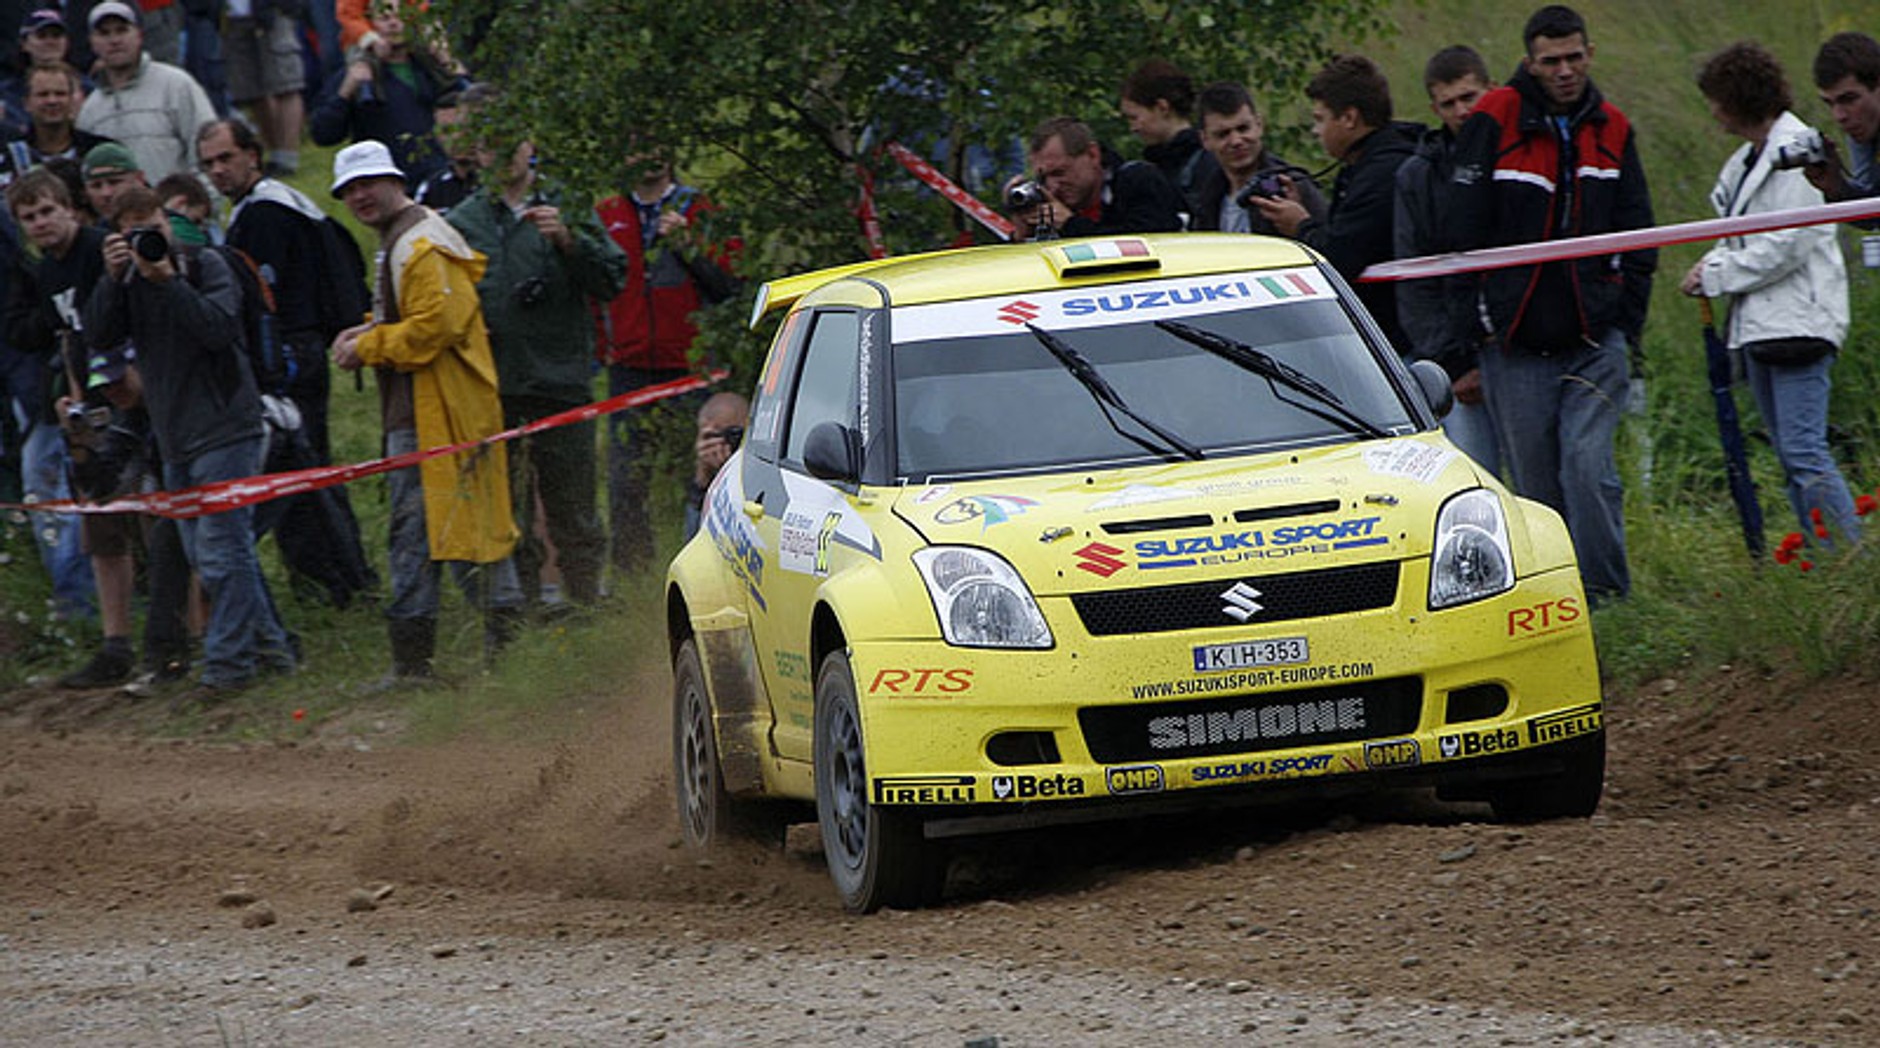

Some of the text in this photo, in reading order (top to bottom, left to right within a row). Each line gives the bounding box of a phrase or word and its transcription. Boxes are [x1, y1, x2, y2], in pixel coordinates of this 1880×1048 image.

[1062, 281, 1251, 316] SUZUKI
[1134, 516, 1381, 558] SUZUKI SPORT
[1201, 544, 1329, 566] EUROPE
[1508, 597, 1580, 636] RTS
[1211, 641, 1301, 667] KIH-353
[869, 669, 975, 694] RTS
[1132, 662, 1374, 700] WWW.SUZUKISPORT-EUROPE.COM
[1149, 697, 1366, 749] SIMONE
[1462, 729, 1519, 751] Beta
[1192, 754, 1333, 782] SUZUKI SPORT
[873, 777, 976, 802] PIRELLI
[1017, 776, 1084, 797] Beta
